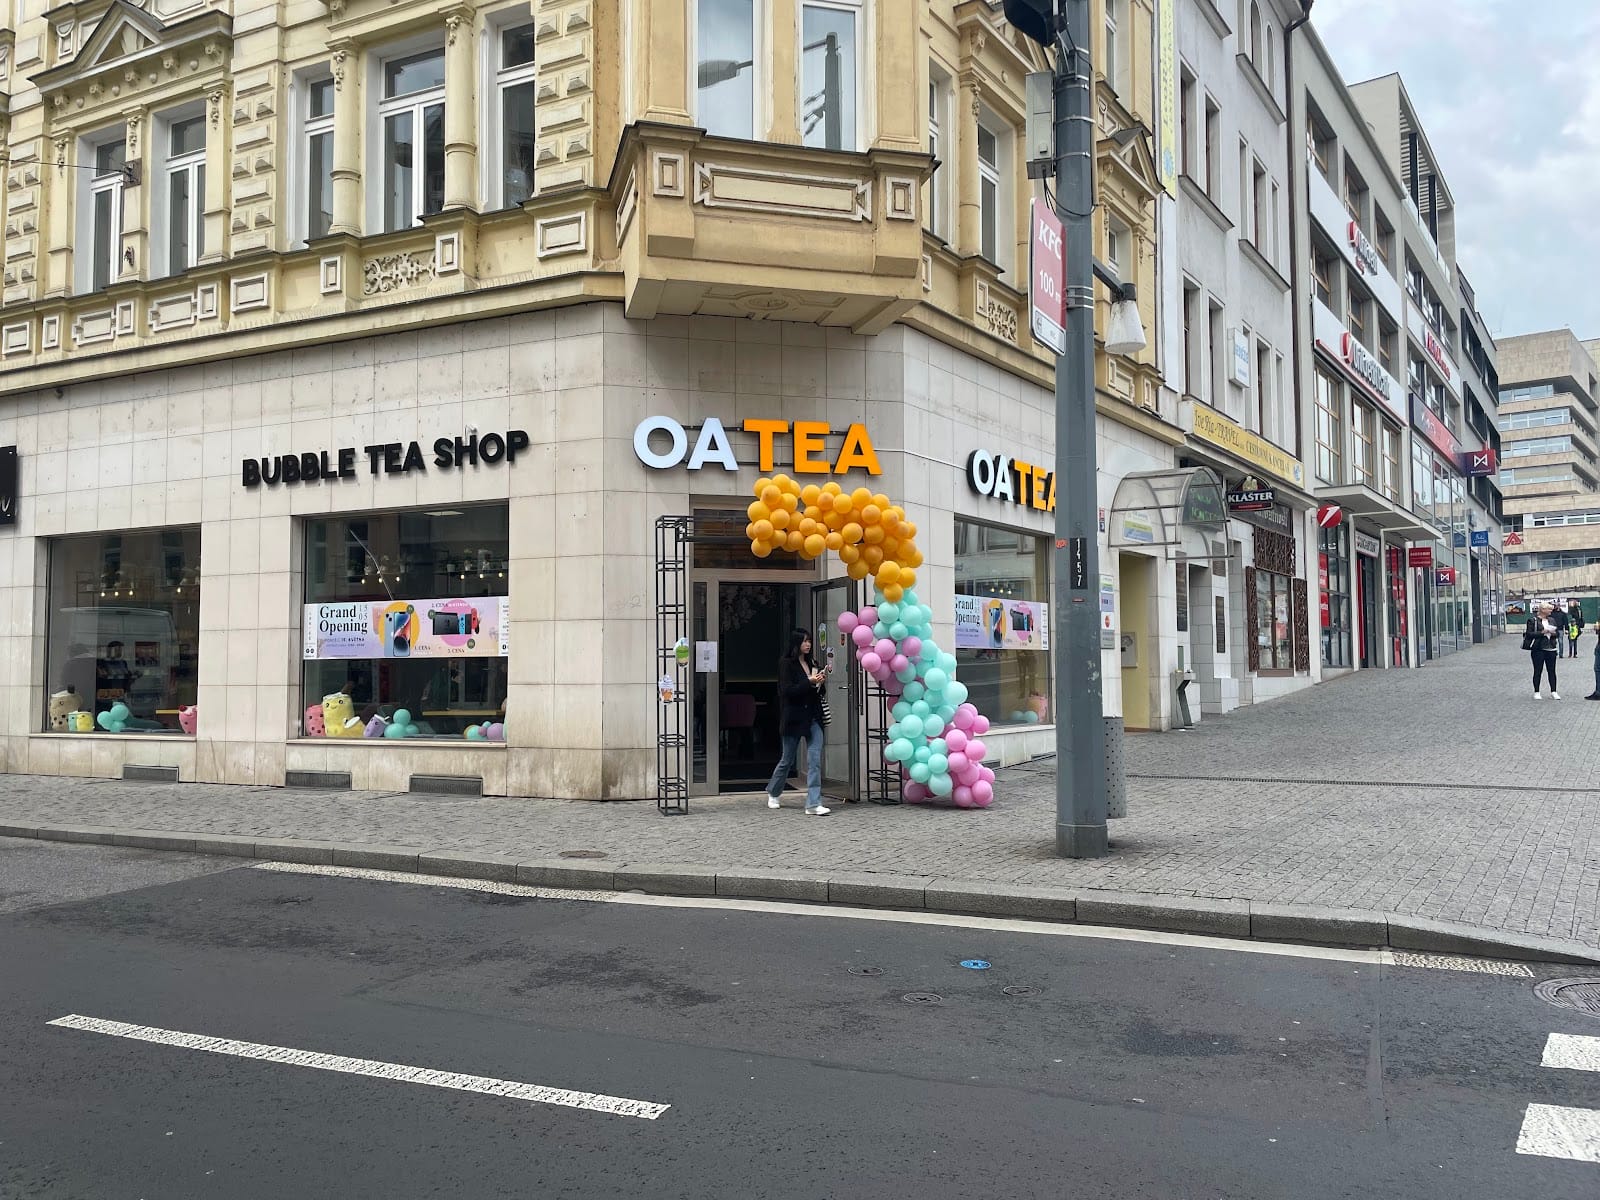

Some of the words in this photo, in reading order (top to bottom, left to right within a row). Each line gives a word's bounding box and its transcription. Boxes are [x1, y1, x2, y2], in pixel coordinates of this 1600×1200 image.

[1038, 219, 1063, 260] KFC
[1040, 269, 1054, 299] 100
[242, 448, 356, 488] BUBBLE
[364, 441, 426, 475] TEA
[433, 429, 528, 469] SHOP
[319, 604, 357, 619] Grand
[319, 618, 368, 635] Opening
